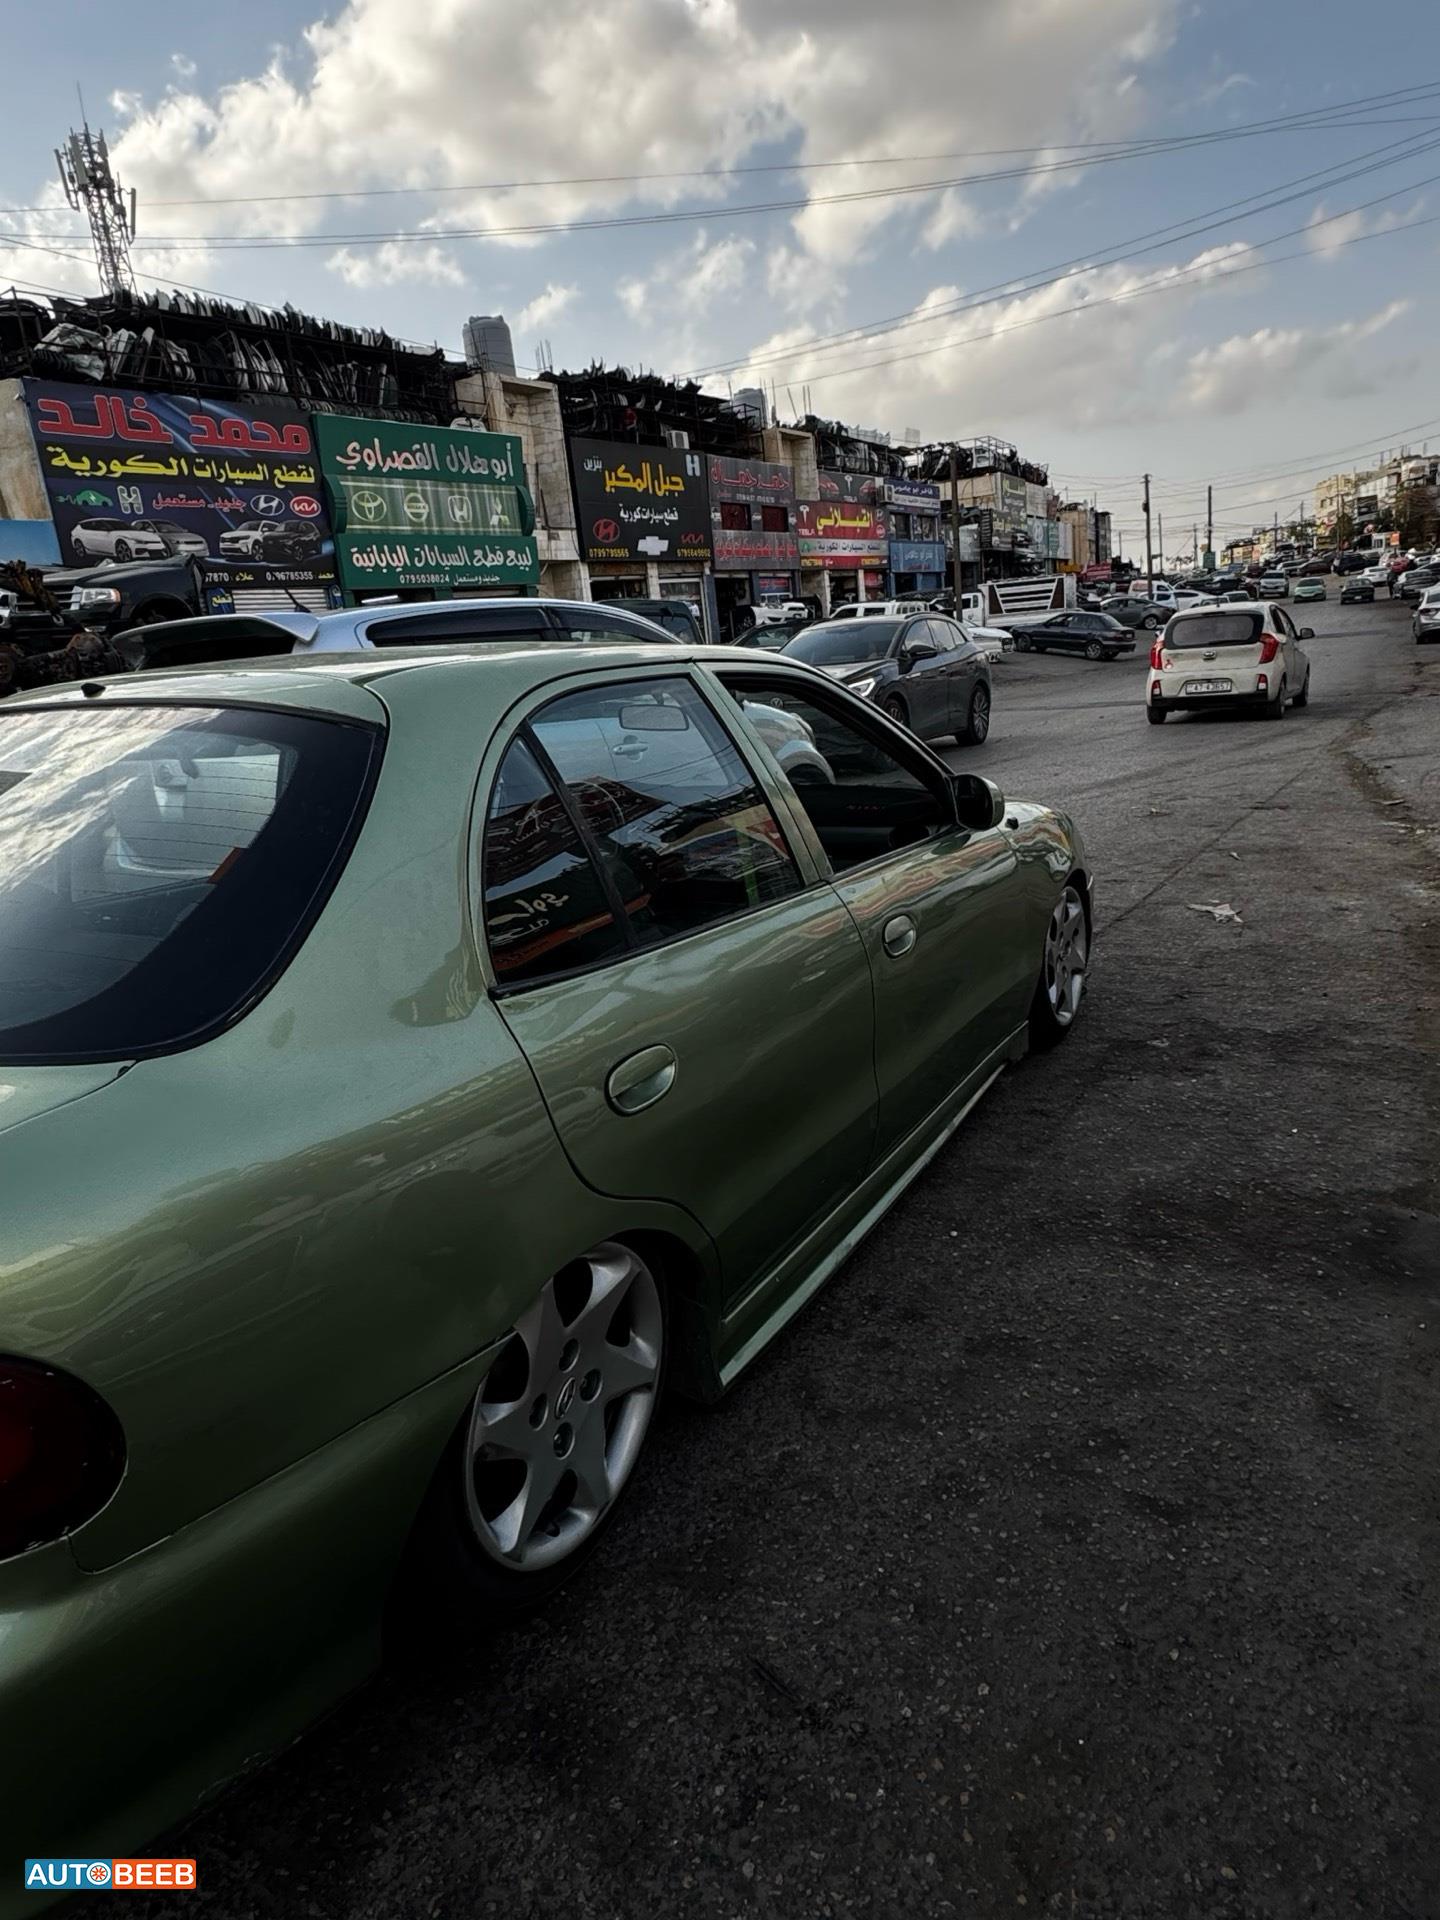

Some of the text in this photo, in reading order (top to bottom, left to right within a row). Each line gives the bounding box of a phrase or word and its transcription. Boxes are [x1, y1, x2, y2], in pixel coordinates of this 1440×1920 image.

[38, 394, 311, 455] محمد خالد
[46, 445, 317, 489] لقطع السيارات الكورية
[336, 437, 441, 474] القصراوي
[446, 444, 489, 476] هلال
[604, 462, 685, 497] جبل المكبر
[153, 491, 207, 509] مستعمل
[350, 544, 533, 573] لبيع قطع السيارات اليابانية
